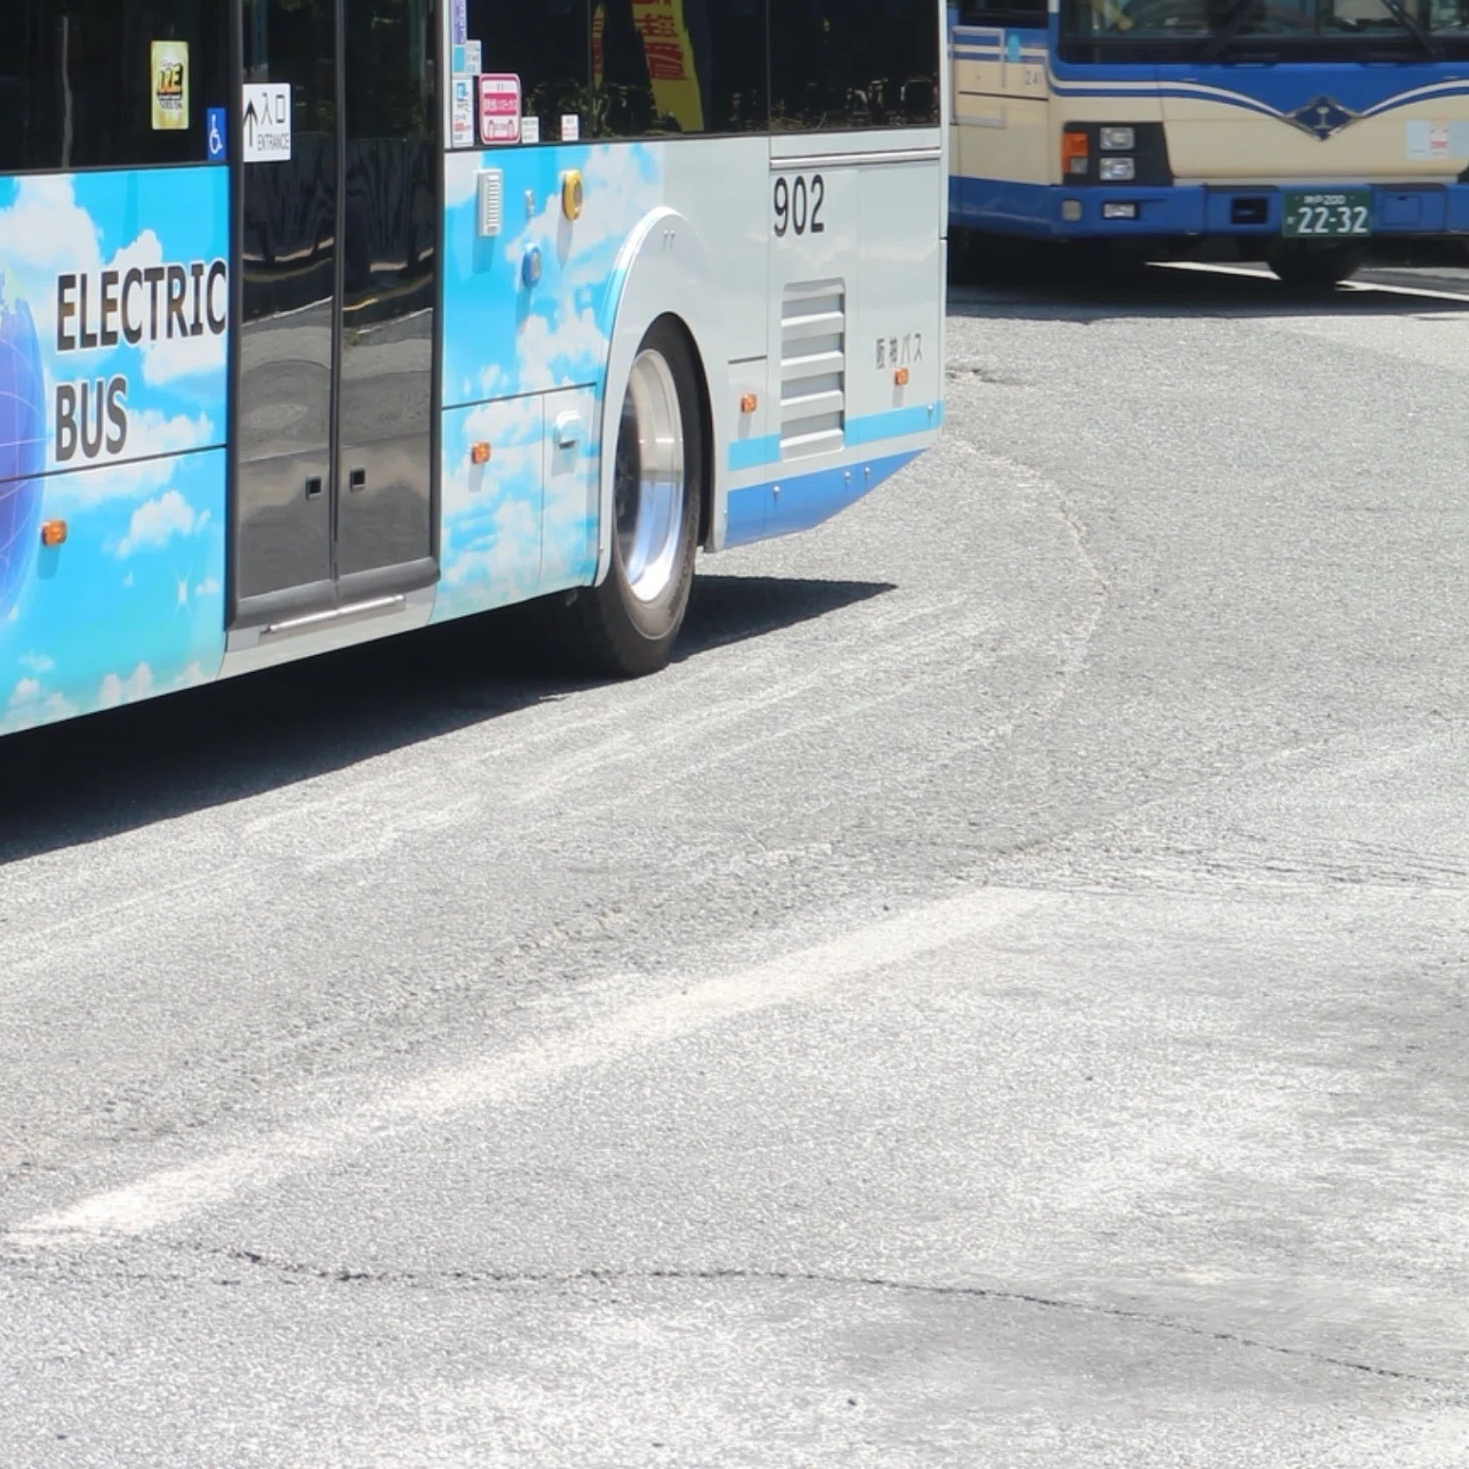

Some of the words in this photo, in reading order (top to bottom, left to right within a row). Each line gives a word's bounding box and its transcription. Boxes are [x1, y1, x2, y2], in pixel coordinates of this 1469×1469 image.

[260, 91, 286, 125] 入口
[257, 133, 290, 151] ENTRANCE
[773, 174, 825, 238] 902
[1297, 206, 1369, 234] 22-32
[57, 259, 228, 352] ELECTRIC
[875, 332, 923, 370] 阪神バス
[55, 376, 128, 463] BUS
